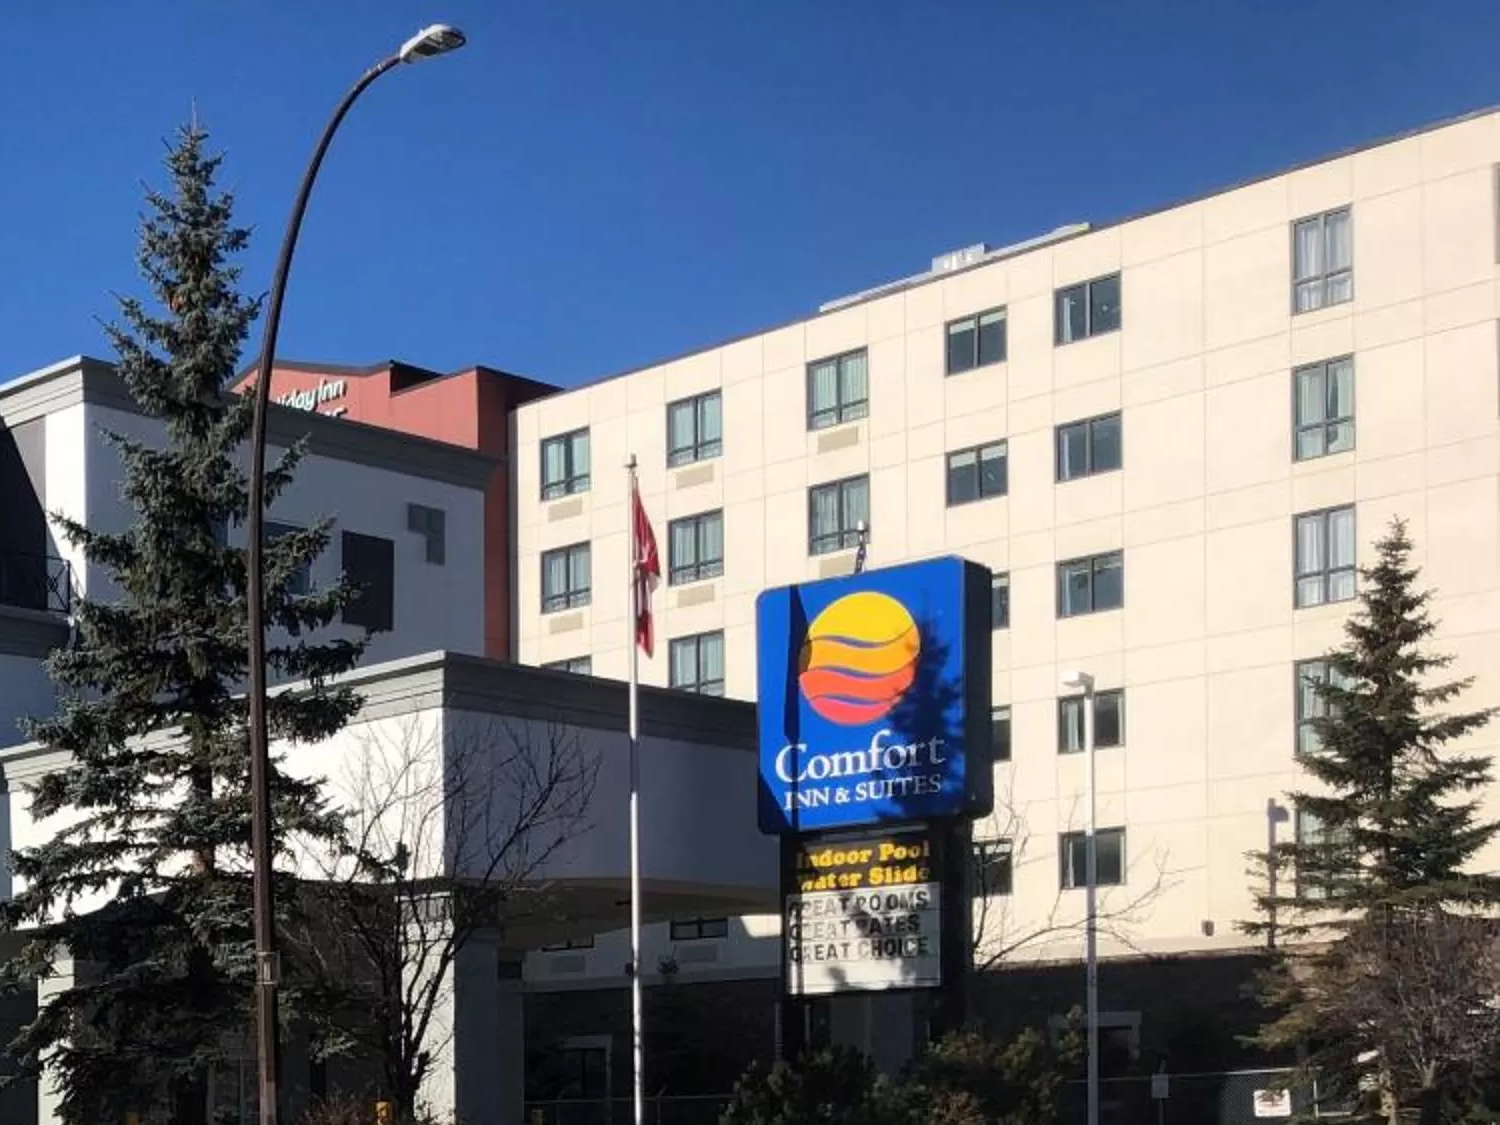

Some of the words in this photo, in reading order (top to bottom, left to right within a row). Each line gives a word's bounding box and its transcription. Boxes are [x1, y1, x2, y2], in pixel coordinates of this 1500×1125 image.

[317, 376, 345, 403] Inn
[775, 729, 947, 783] Comfort
[784, 786, 830, 811] INN
[835, 786, 851, 804] &
[855, 773, 942, 801] SUITES
[878, 839, 931, 862] Pool
[868, 863, 931, 886] Slide
[790, 941, 851, 962] GREAT
[857, 935, 928, 961] CHOICE
